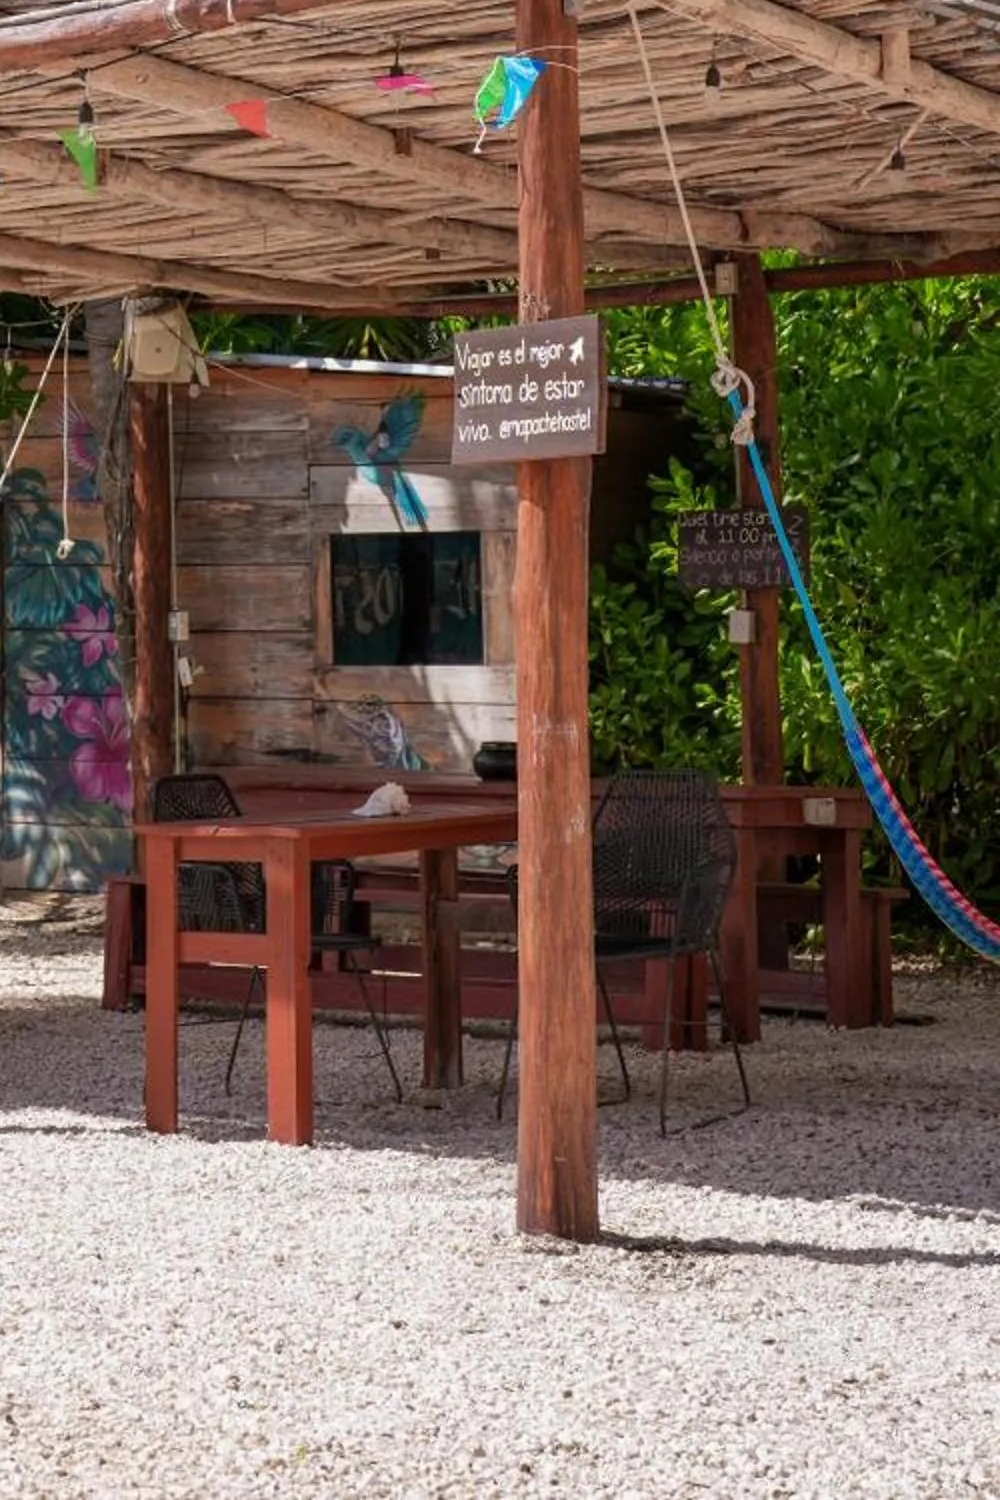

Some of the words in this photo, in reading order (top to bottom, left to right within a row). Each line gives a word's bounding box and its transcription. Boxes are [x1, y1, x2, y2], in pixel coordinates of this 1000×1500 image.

[455, 342, 495, 377] Viajar
[498, 348, 512, 366] es
[514, 337, 526, 365] el
[530, 340, 565, 369] mejor
[519, 373, 539, 403] de
[544, 371, 585, 400] estar
